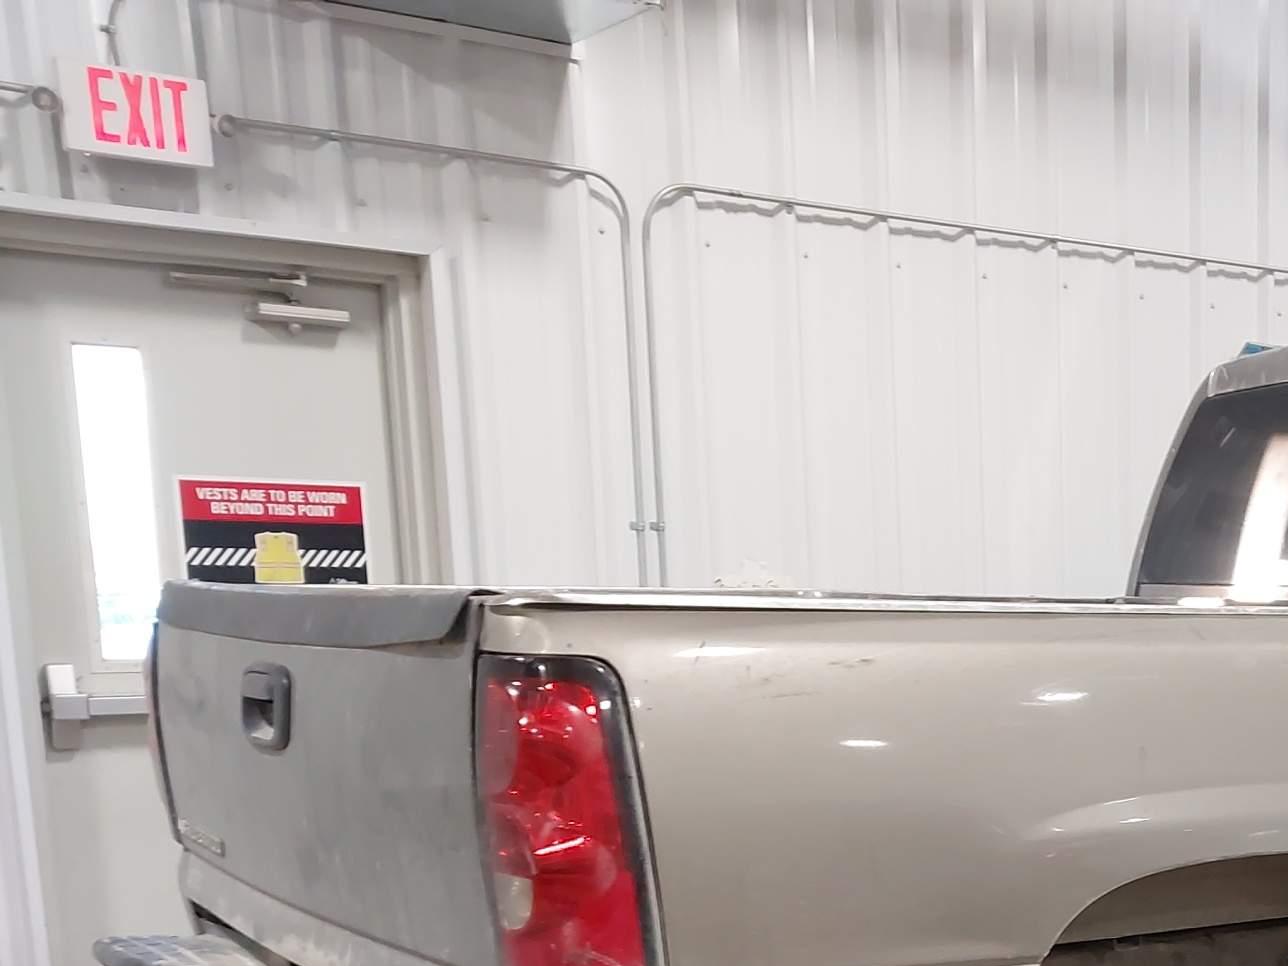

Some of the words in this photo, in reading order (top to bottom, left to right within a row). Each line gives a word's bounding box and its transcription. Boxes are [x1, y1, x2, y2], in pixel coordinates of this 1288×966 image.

[87, 66, 187, 152] EXIT
[194, 487, 239, 500] VESTS
[240, 488, 267, 501] ARE
[267, 489, 286, 502] TO
[287, 490, 306, 503] BE
[306, 491, 348, 505] WORN
[209, 501, 265, 515] BEYOND
[265, 503, 297, 517] THIS
[297, 504, 336, 518] POINT
